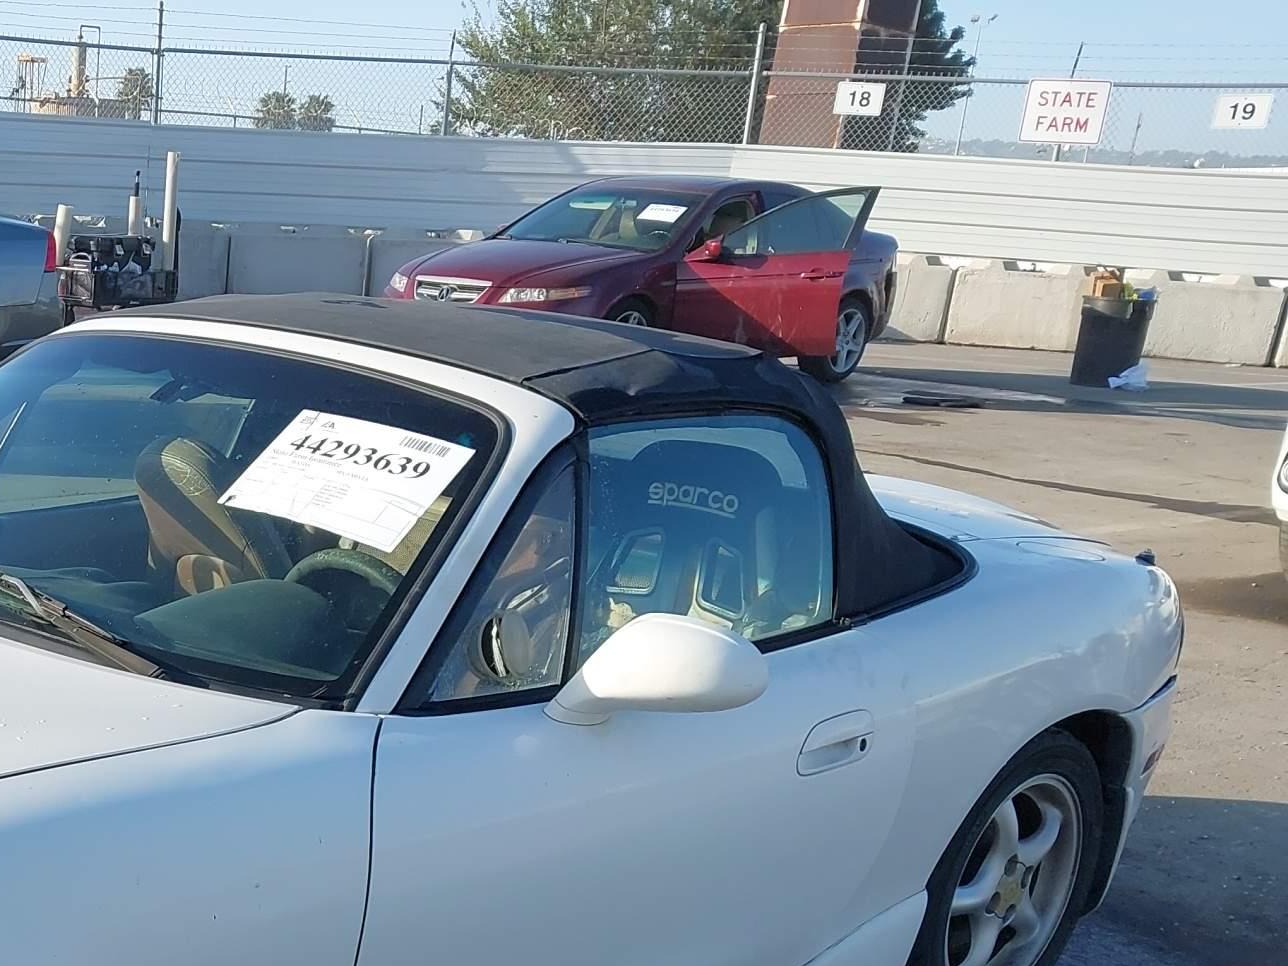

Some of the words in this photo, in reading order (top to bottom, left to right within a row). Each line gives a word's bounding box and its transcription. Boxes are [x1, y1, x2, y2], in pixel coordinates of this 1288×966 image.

[848, 91, 871, 107] 18
[1037, 90, 1098, 109] STATE
[1229, 103, 1257, 121] 19
[1035, 115, 1089, 133] FARM
[290, 434, 431, 479] 44293639
[647, 481, 739, 514] sparco
